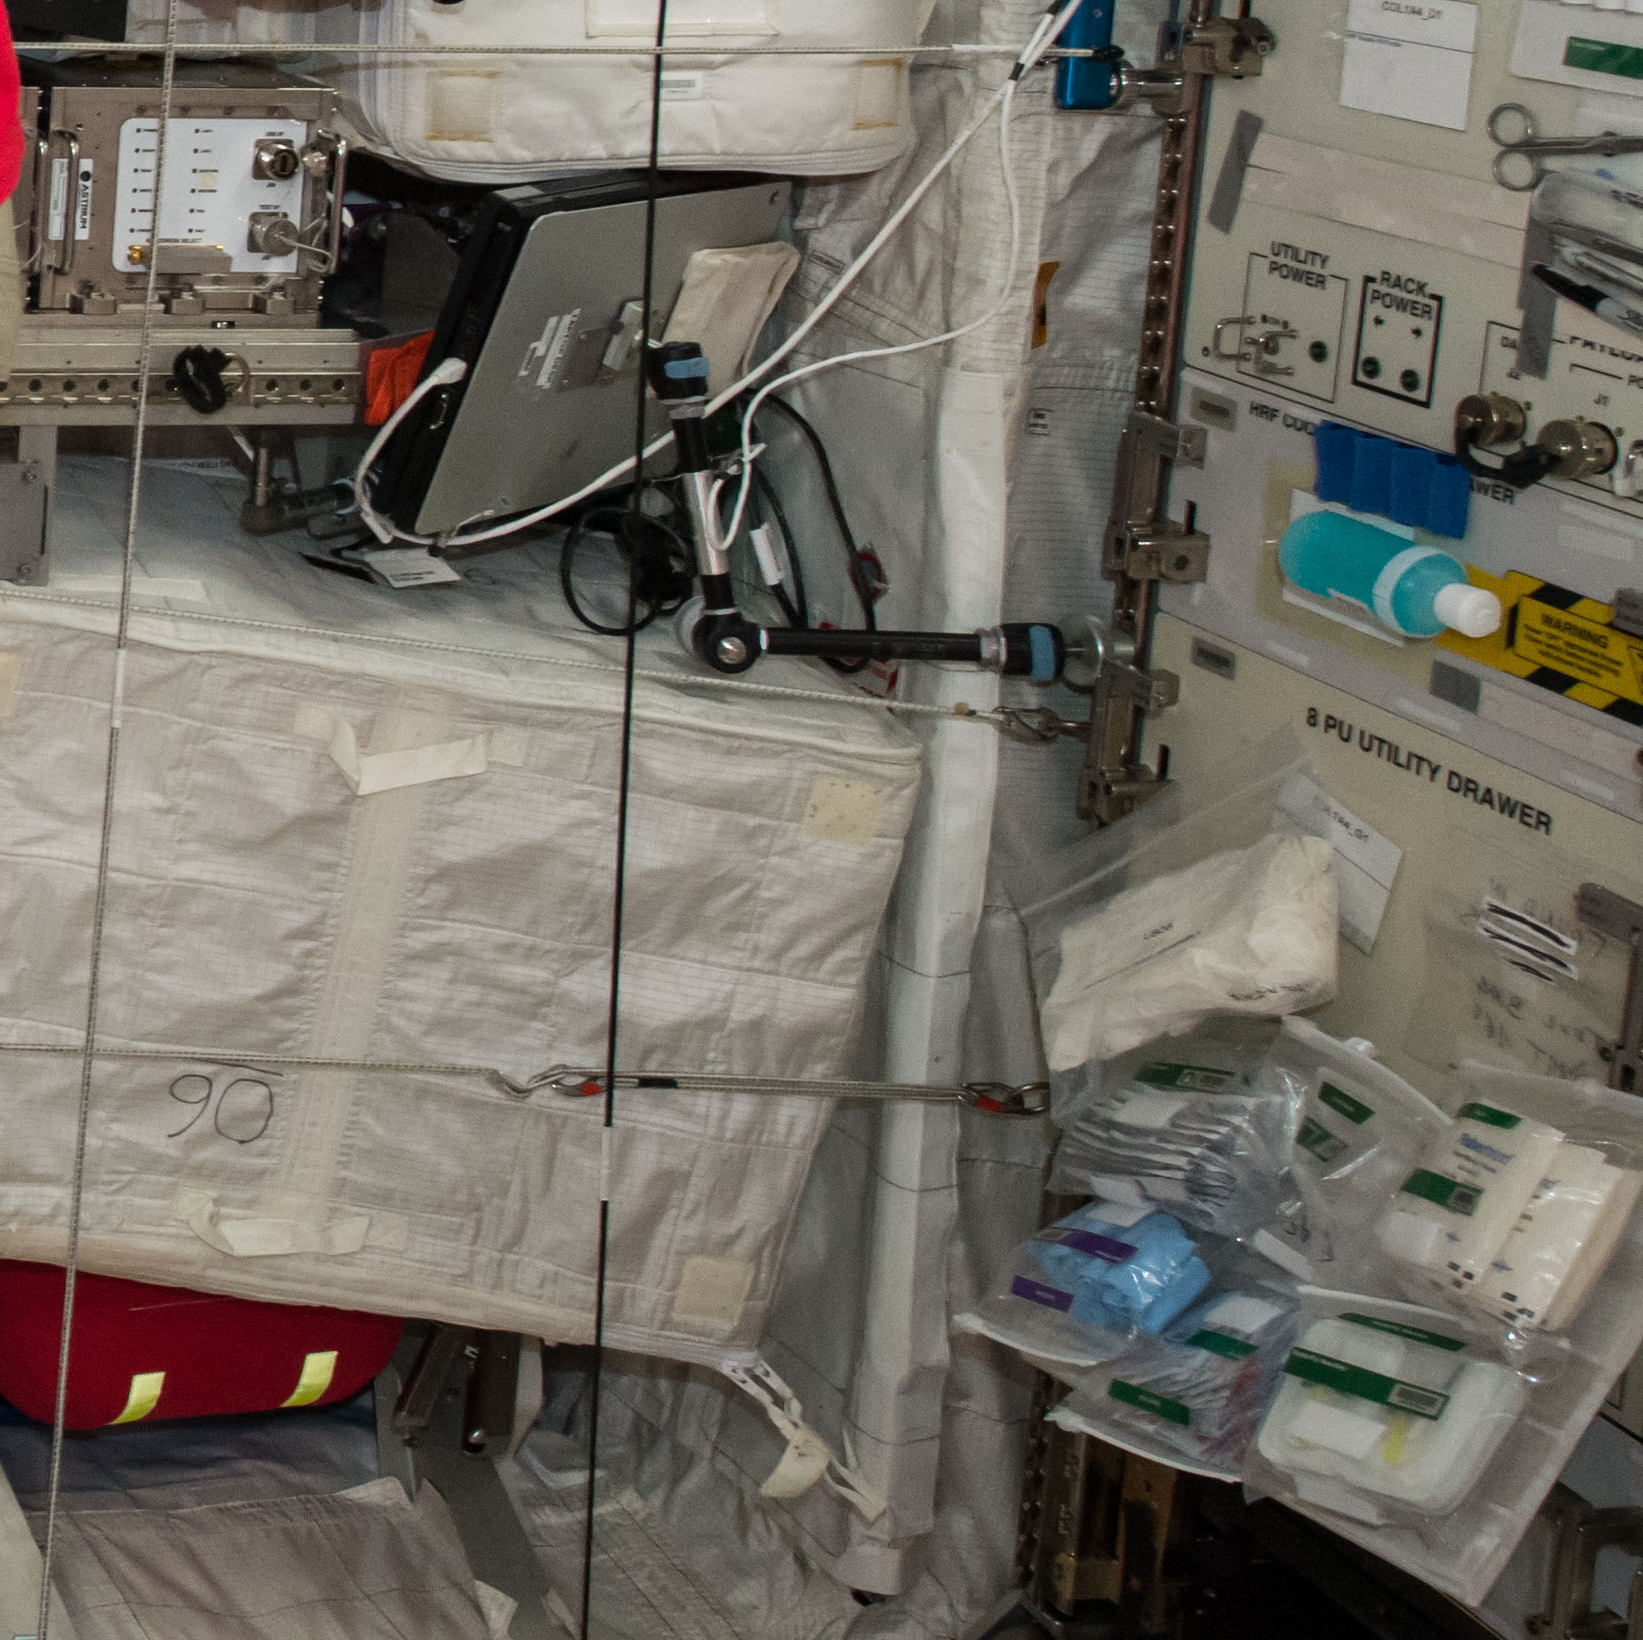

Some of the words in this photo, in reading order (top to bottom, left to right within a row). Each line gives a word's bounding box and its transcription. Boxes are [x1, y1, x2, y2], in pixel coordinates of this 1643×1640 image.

[1271, 241, 1330, 269] UTILITY
[1269, 261, 1327, 290] POWER
[1379, 270, 1429, 297] RACK
[1370, 289, 1433, 321] POWER
[1249, 401, 1280, 423] HRF
[1541, 612, 1609, 652] WARNING
[1306, 708, 1317, 728] 8
[1323, 714, 1352, 744] PU
[1358, 728, 1441, 783] UTILITY
[1446, 770, 1553, 836] DRAWER
[166, 1071, 276, 1143] 90
